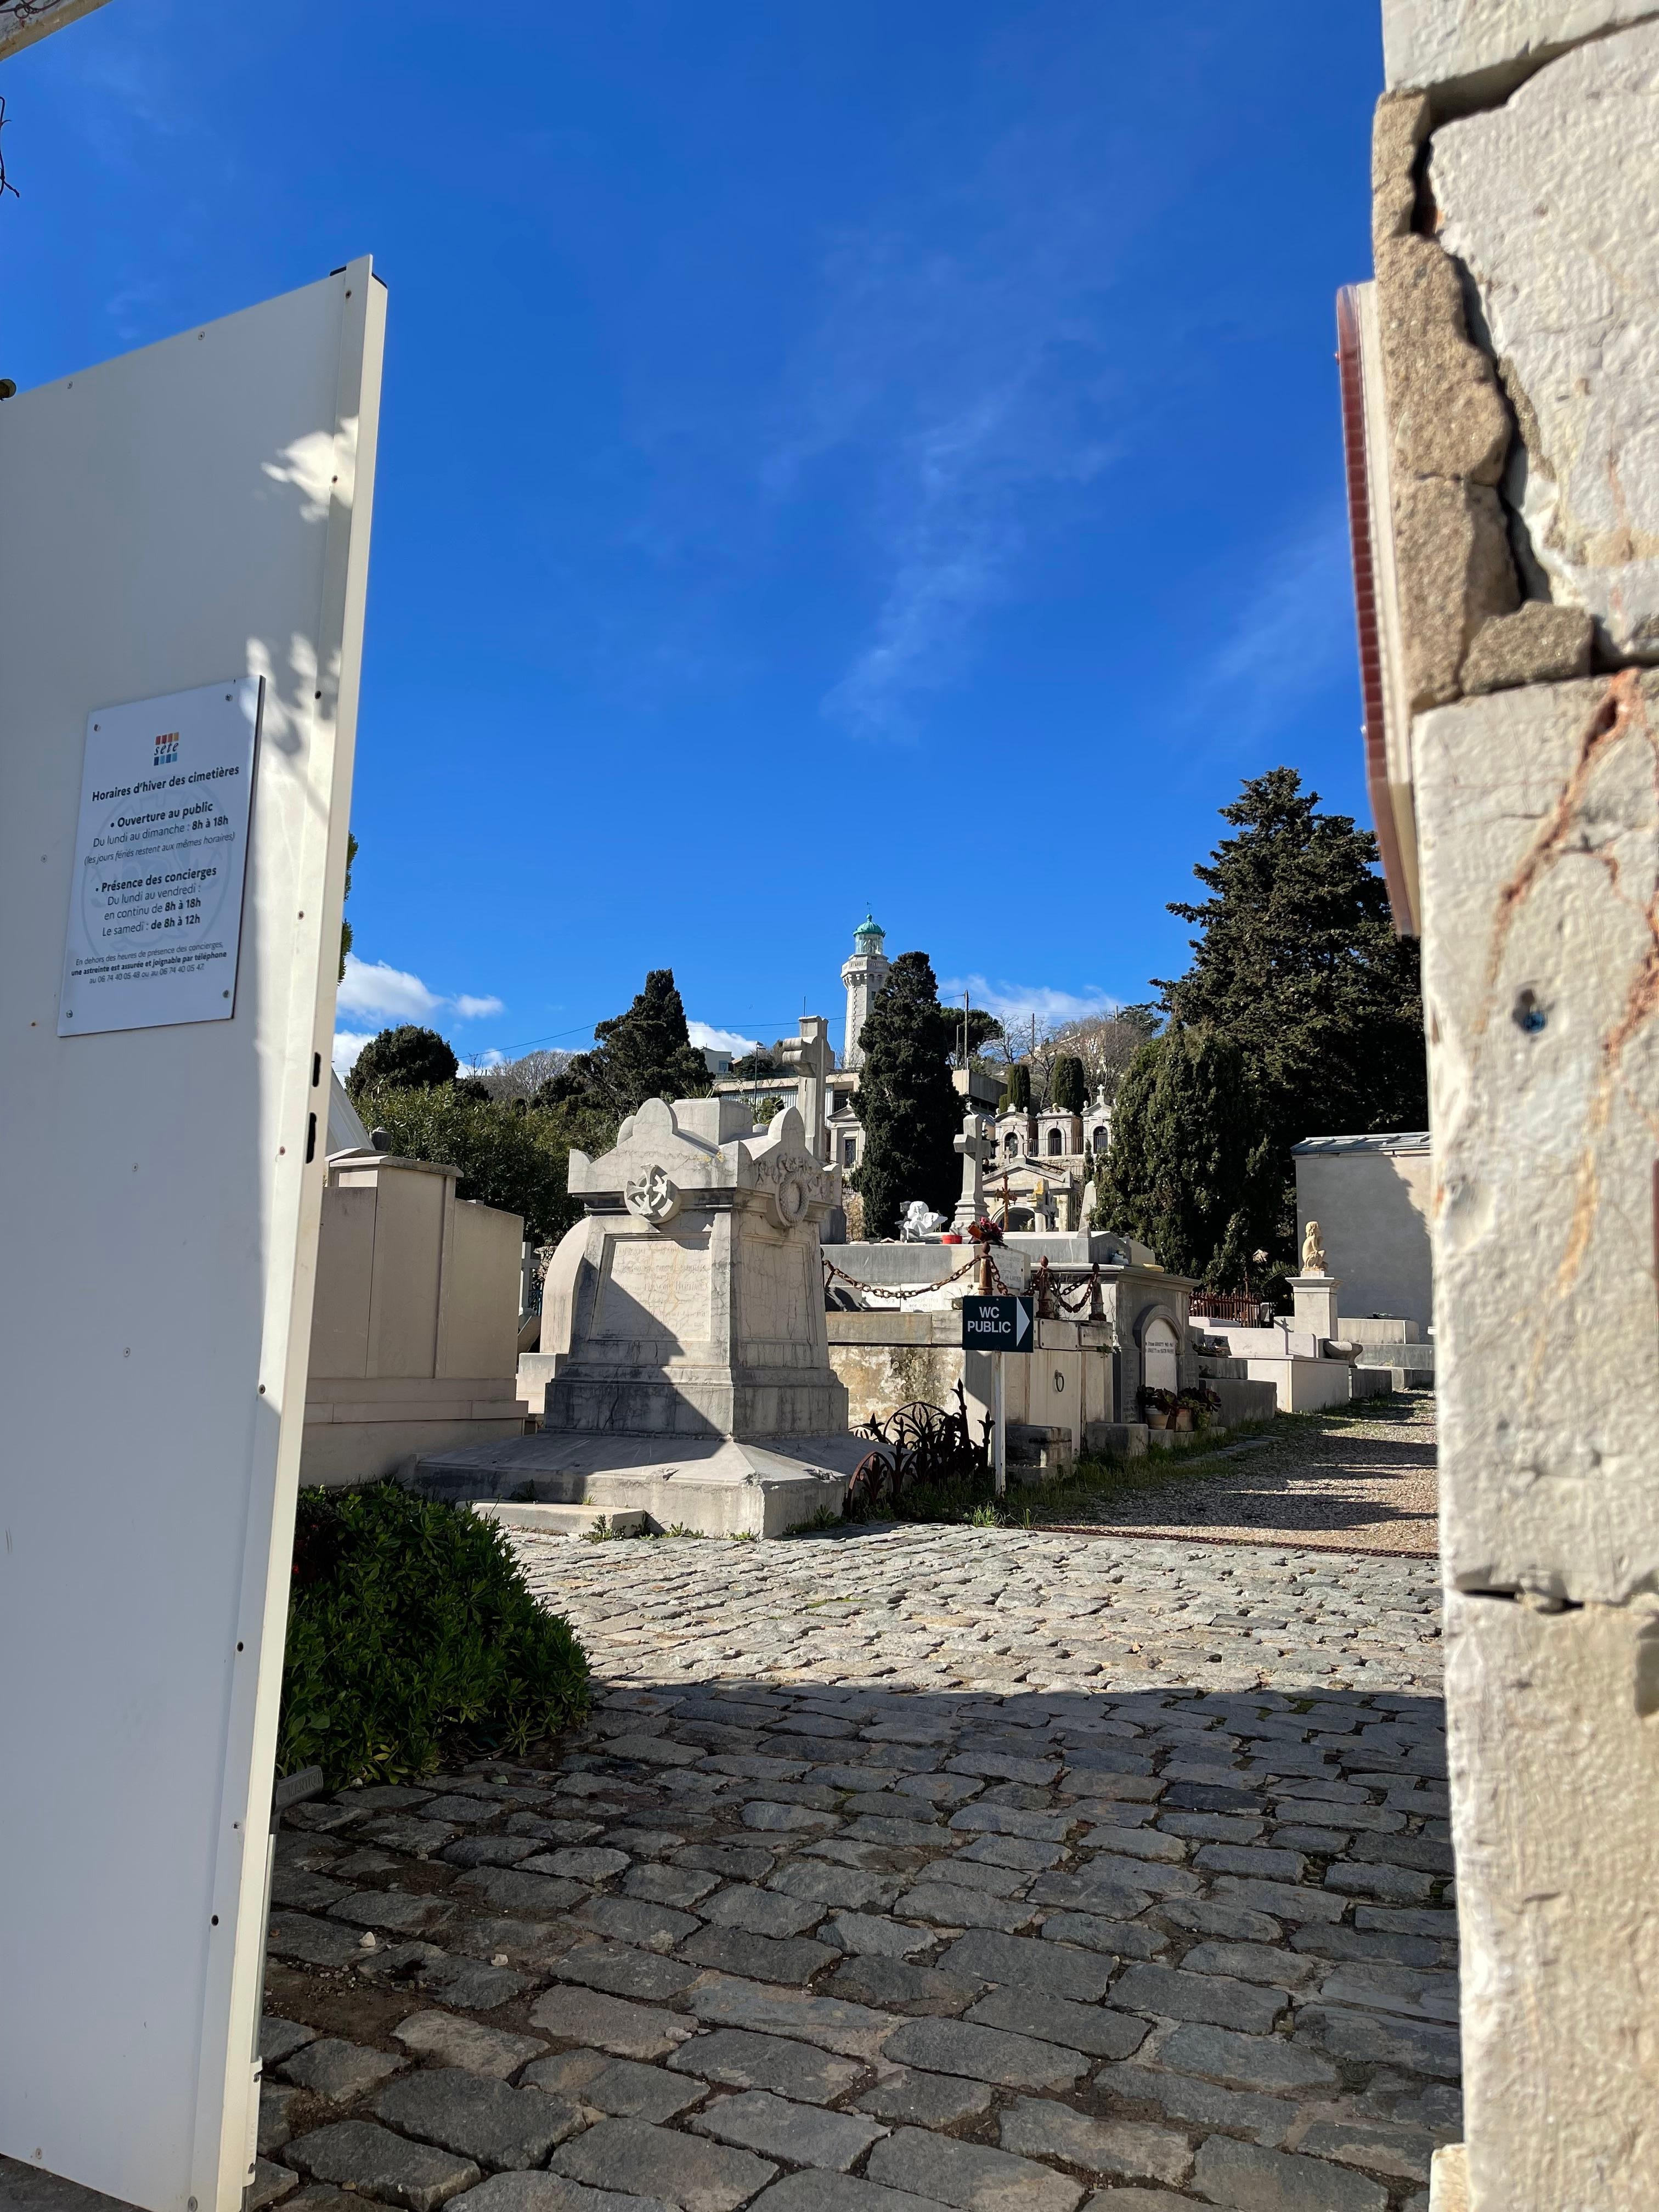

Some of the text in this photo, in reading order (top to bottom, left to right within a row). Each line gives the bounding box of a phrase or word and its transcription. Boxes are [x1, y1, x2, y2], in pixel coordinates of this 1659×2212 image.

[92, 786, 131, 802] Horaires
[168, 775, 185, 787] des
[188, 766, 240, 783] cimetières
[117, 801, 213, 828] Ouverture au public
[93, 838, 105, 848] Du
[107, 832, 128, 845] lundi
[129, 832, 140, 841] au
[142, 823, 185, 839] dimanche
[191, 819, 204, 831] 8h
[205, 818, 211, 828] à
[213, 815, 229, 827] 18h
[84, 831, 236, 866] (les jours fériés restent aux mêmes horaires)
[101, 867, 217, 893] Présence des concierges
[107, 896, 119, 906] Du
[121, 891, 143, 904] lundi
[144, 892, 155, 900] au
[157, 882, 196, 899] vendredi
[104, 897, 201, 921] en continu de 8h à 18h
[102, 927, 111, 936] Le
[113, 921, 144, 935] samedi
[150, 919, 162, 930] de
[163, 917, 176, 928] 8h
[177, 916, 183, 927] à
[184, 913, 201, 925] 12h
[75, 958, 83, 966] En
[84, 956, 105, 965] dehors
[138, 950, 146, 958] de
[146, 947, 175, 958] présence
[176, 944, 188, 953] des
[83, 966, 110, 975] astreinte
[121, 961, 144, 970] assurée
[151, 955, 182, 968] joignable
[182, 956, 194, 964] par
[194, 951, 228, 962] téléphone
[979, 1306, 1000, 1318] WC
[967, 1321, 1011, 1333] PUBLIC
